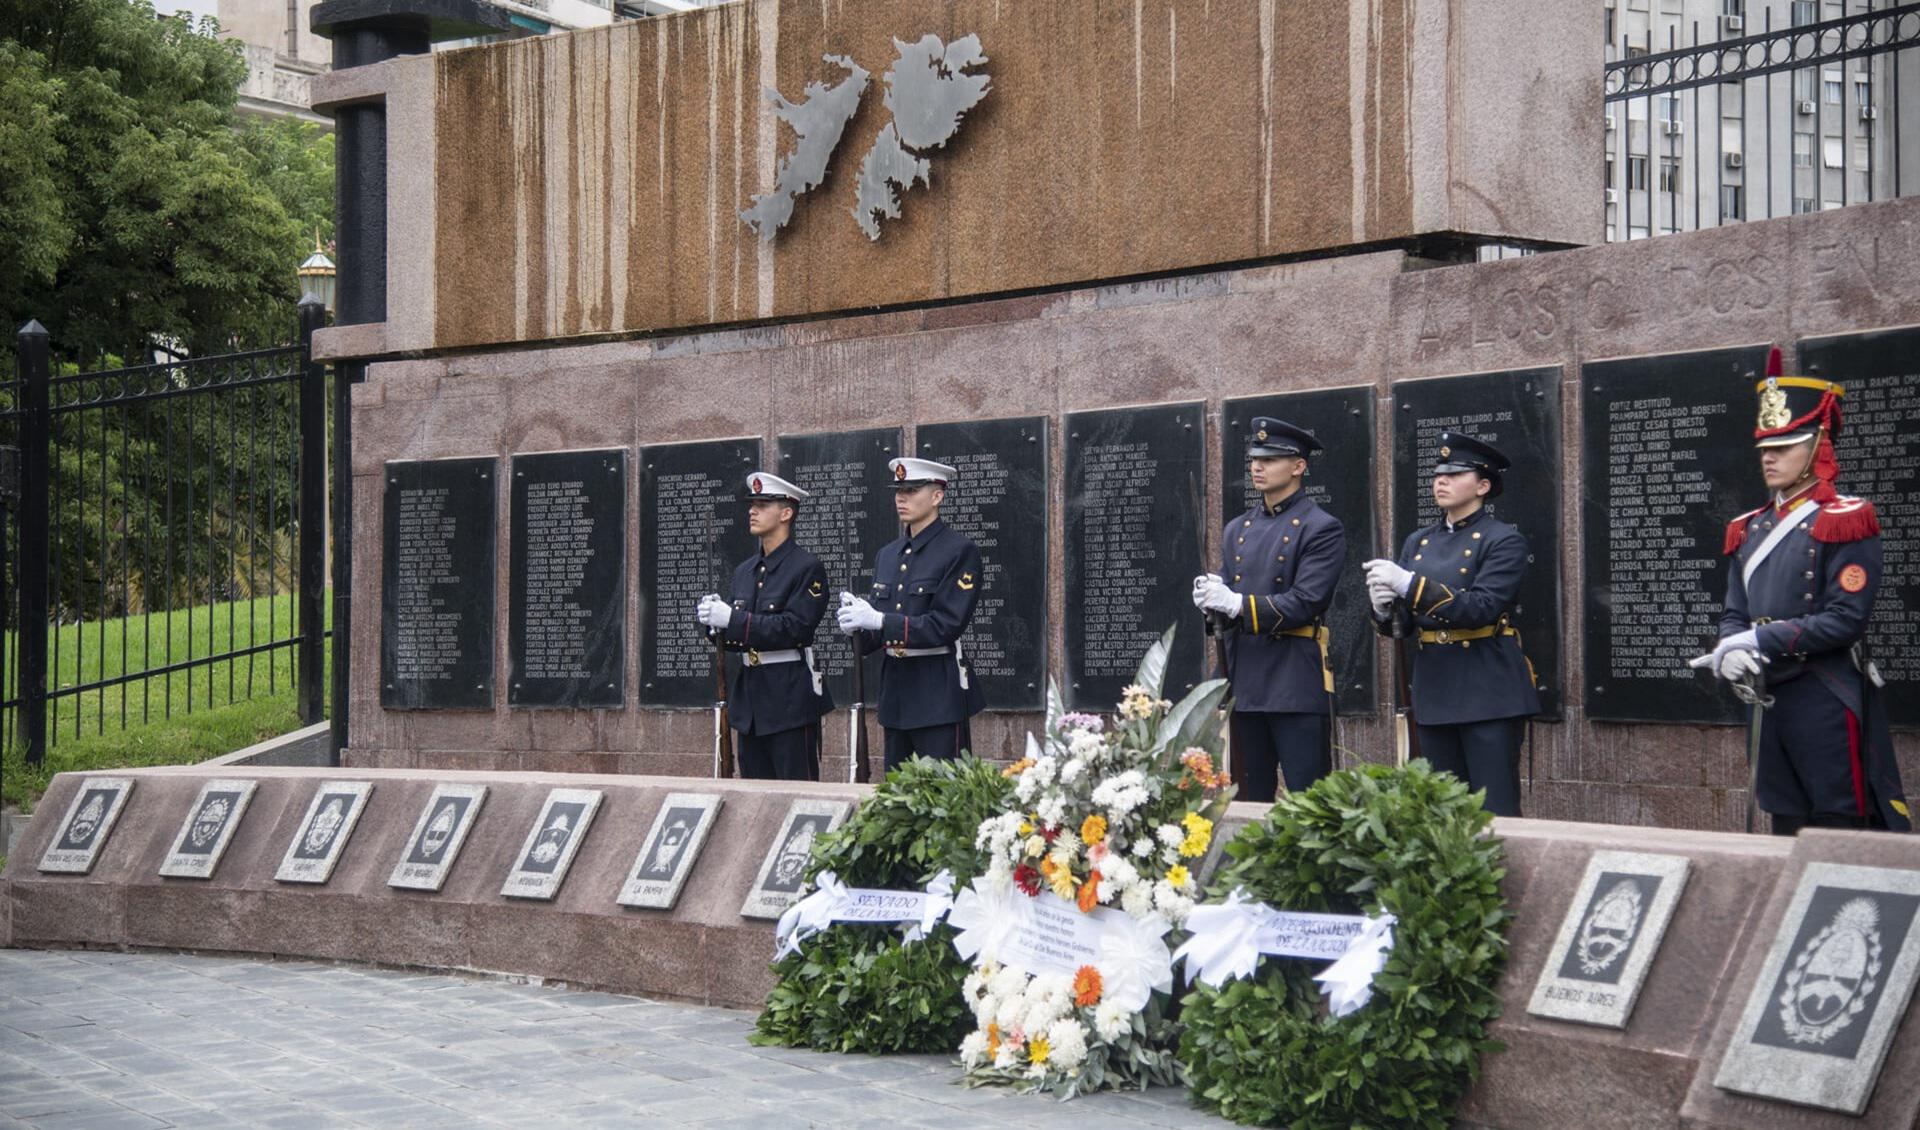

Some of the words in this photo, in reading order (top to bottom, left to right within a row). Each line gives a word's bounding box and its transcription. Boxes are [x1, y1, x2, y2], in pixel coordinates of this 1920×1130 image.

[1473, 285, 1561, 347] LOS
[1633, 398, 1671, 410] RESTITUTO
[1462, 413, 1493, 424] EDUARDO
[1495, 412, 1512, 422] JOSE
[1609, 410, 1650, 422] PRAMPARO
[1652, 407, 1689, 419] EDGARDO
[1691, 404, 1727, 416] ROBERTO
[1465, 424, 1479, 434] LUIS
[1610, 422, 1641, 433] ALVAREZ
[1644, 419, 1669, 430] CESAR
[1672, 417, 1705, 428] ERNESTO
[1478, 433, 1497, 443] OMAR
[1610, 433, 1638, 444] FATTORI
[1641, 430, 1670, 441] GABRIEL
[1674, 427, 1708, 439] GUSTAVO
[1610, 443, 1644, 454] MENDOZA
[1610, 455, 1629, 465] RIVAS
[1634, 452, 1668, 464] ABRAHAM
[1671, 450, 1697, 461] RAFAEL
[1609, 465, 1628, 475] FAUR
[1631, 464, 1649, 474] JOSE
[1652, 462, 1675, 473] DANTE
[1610, 475, 1642, 486] MARIZZA
[1646, 474, 1669, 484] GUIDO
[1672, 472, 1704, 483] ANTONIO
[1647, 484, 1672, 495] RAMON
[1676, 482, 1711, 493] EDMUNDO
[1648, 495, 1681, 505] OSVALDO
[1684, 493, 1708, 504] ANIBAL
[1418, 507, 1442, 517] VARGAS
[1609, 509, 1620, 518] DE
[1622, 507, 1649, 517] CHIARA
[1652, 505, 1686, 516] ORLANDO
[1610, 518, 1640, 528] GALIANO
[1644, 517, 1661, 527] JOSE
[1636, 528, 1663, 538] VICTOR
[1666, 527, 1684, 537] RAUL
[1610, 540, 1643, 550] FAJARDO
[1646, 539, 1666, 549] SIXTO
[1670, 538, 1696, 548] JAVIER
[1610, 551, 1633, 561] REYES
[1635, 550, 1658, 560] LOBOS
[1661, 550, 1680, 559] JOSE
[1610, 562, 1643, 572] LARROSA
[1646, 561, 1670, 571] PEDRO
[1673, 560, 1716, 570] FLORENTINO
[1611, 573, 1633, 582] AYALA
[1636, 572, 1656, 582] JUAN
[1659, 571, 1701, 581] ALEJANDRO
[1647, 583, 1667, 592] JULIO
[1670, 582, 1696, 592] OSCAR
[1610, 594, 1650, 603] RODRIGUEZ
[1653, 593, 1680, 603] ALEGRE
[1684, 593, 1711, 602] VICTOR
[1610, 605, 1629, 614] SOSA
[1633, 605, 1658, 614] MIGUEL
[1663, 604, 1685, 613] ANGEL
[1691, 604, 1723, 613] ANTONIO
[1611, 637, 1627, 646] RUIZ
[1631, 637, 1663, 646] RICARDO
[1666, 637, 1699, 646] HORACIO
[1611, 648, 1652, 657] FERNANDEZ
[1655, 648, 1676, 657] HUGO
[1679, 648, 1707, 657] RAMON
[1612, 669, 1632, 678] VILCA
[1636, 669, 1668, 678] CONDORI
[1671, 669, 1695, 678] MARIO
[852, 894, 919, 908] SENADO
[1545, 985, 1584, 1002] BUENOS
[1587, 991, 1617, 1007] AIRES
